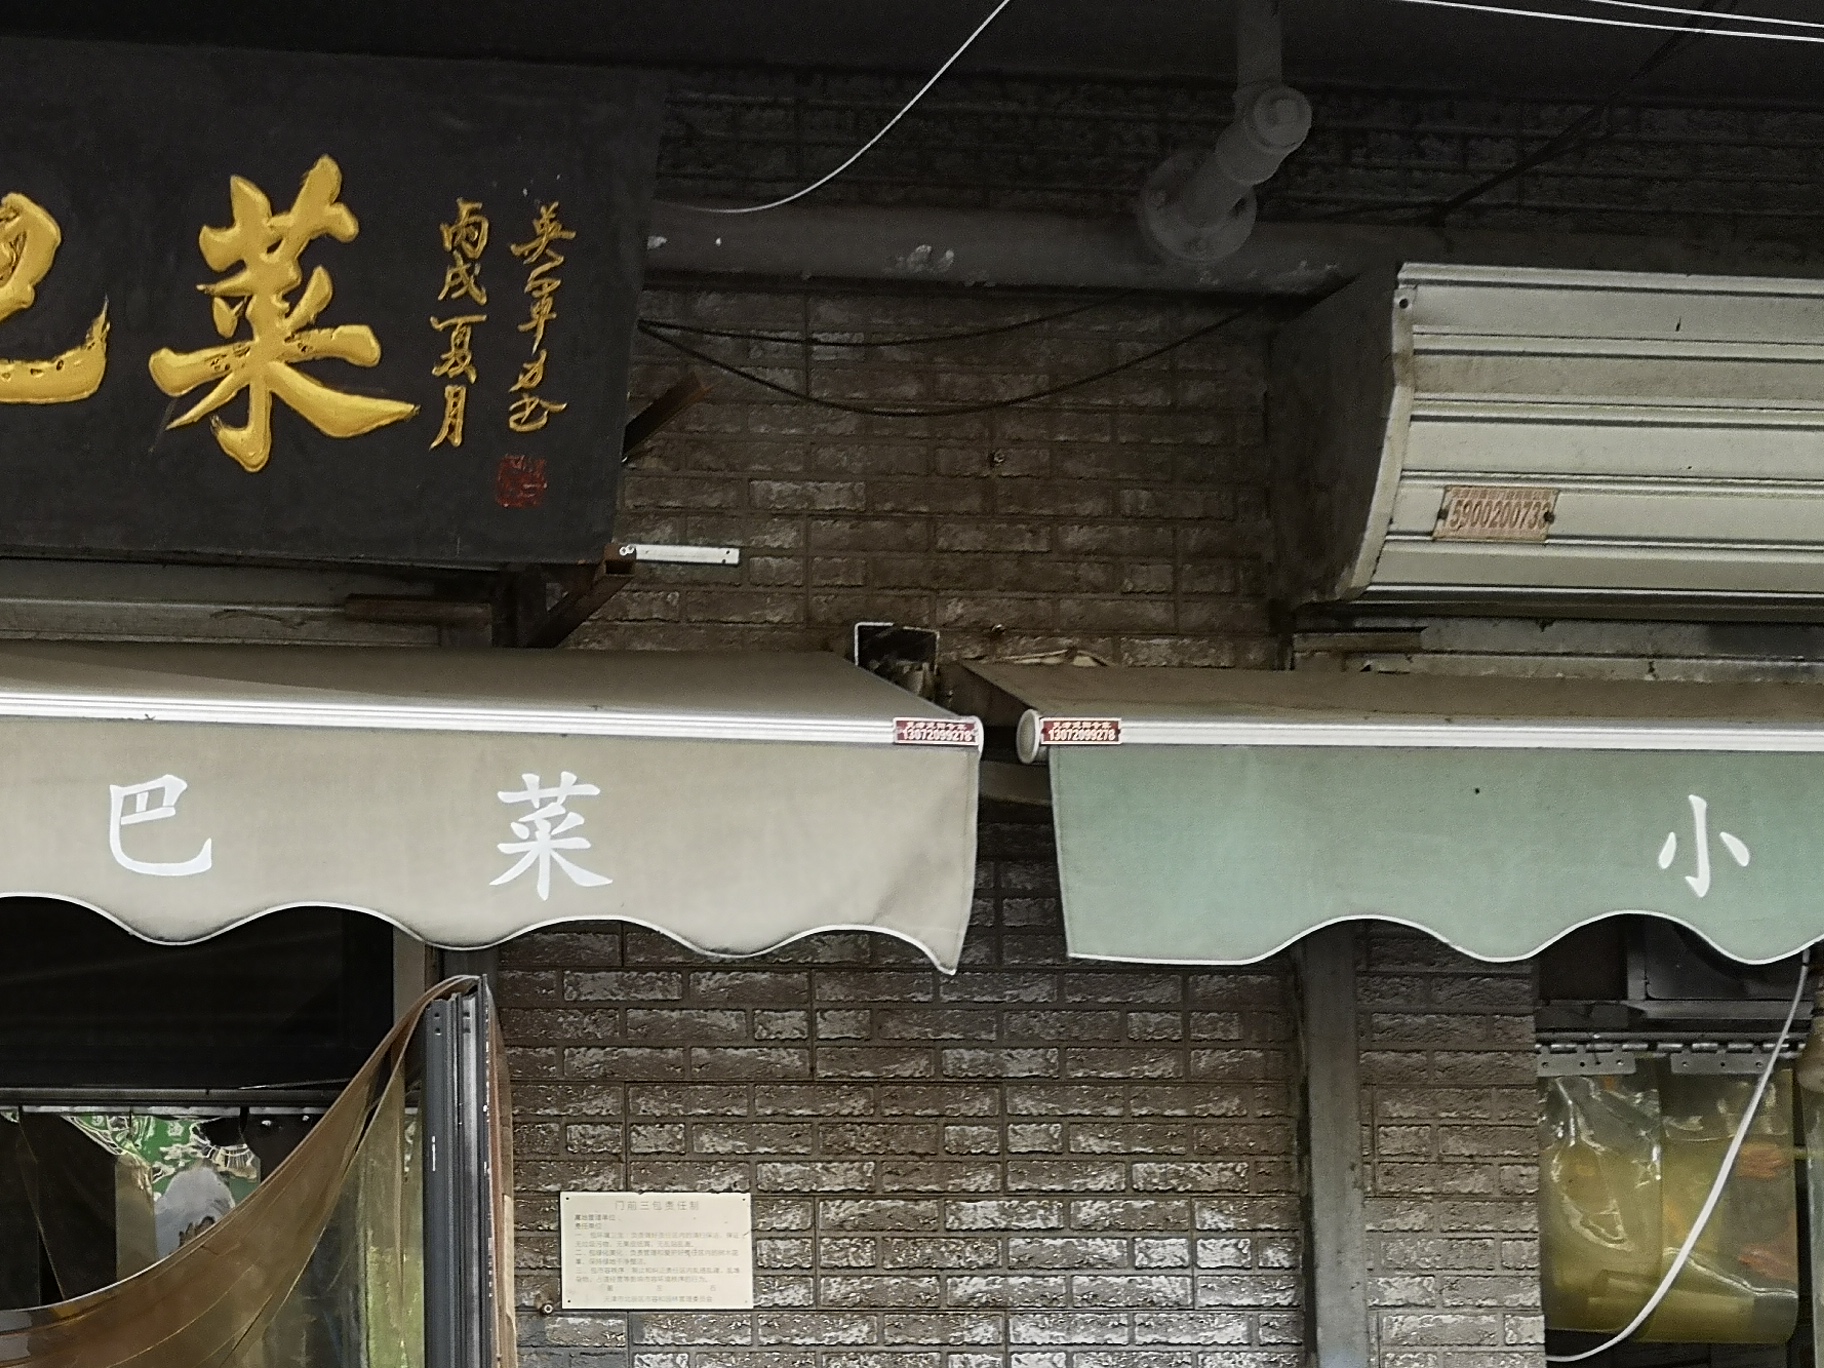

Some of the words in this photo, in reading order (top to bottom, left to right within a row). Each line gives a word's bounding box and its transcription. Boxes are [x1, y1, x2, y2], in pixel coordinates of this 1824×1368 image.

[903, 727, 973, 742] 13072099278
[1048, 728, 1116, 741] 13072099278
[1658, 794, 1751, 898] 小
[614, 1200, 700, 1212] 门前三包责任制
